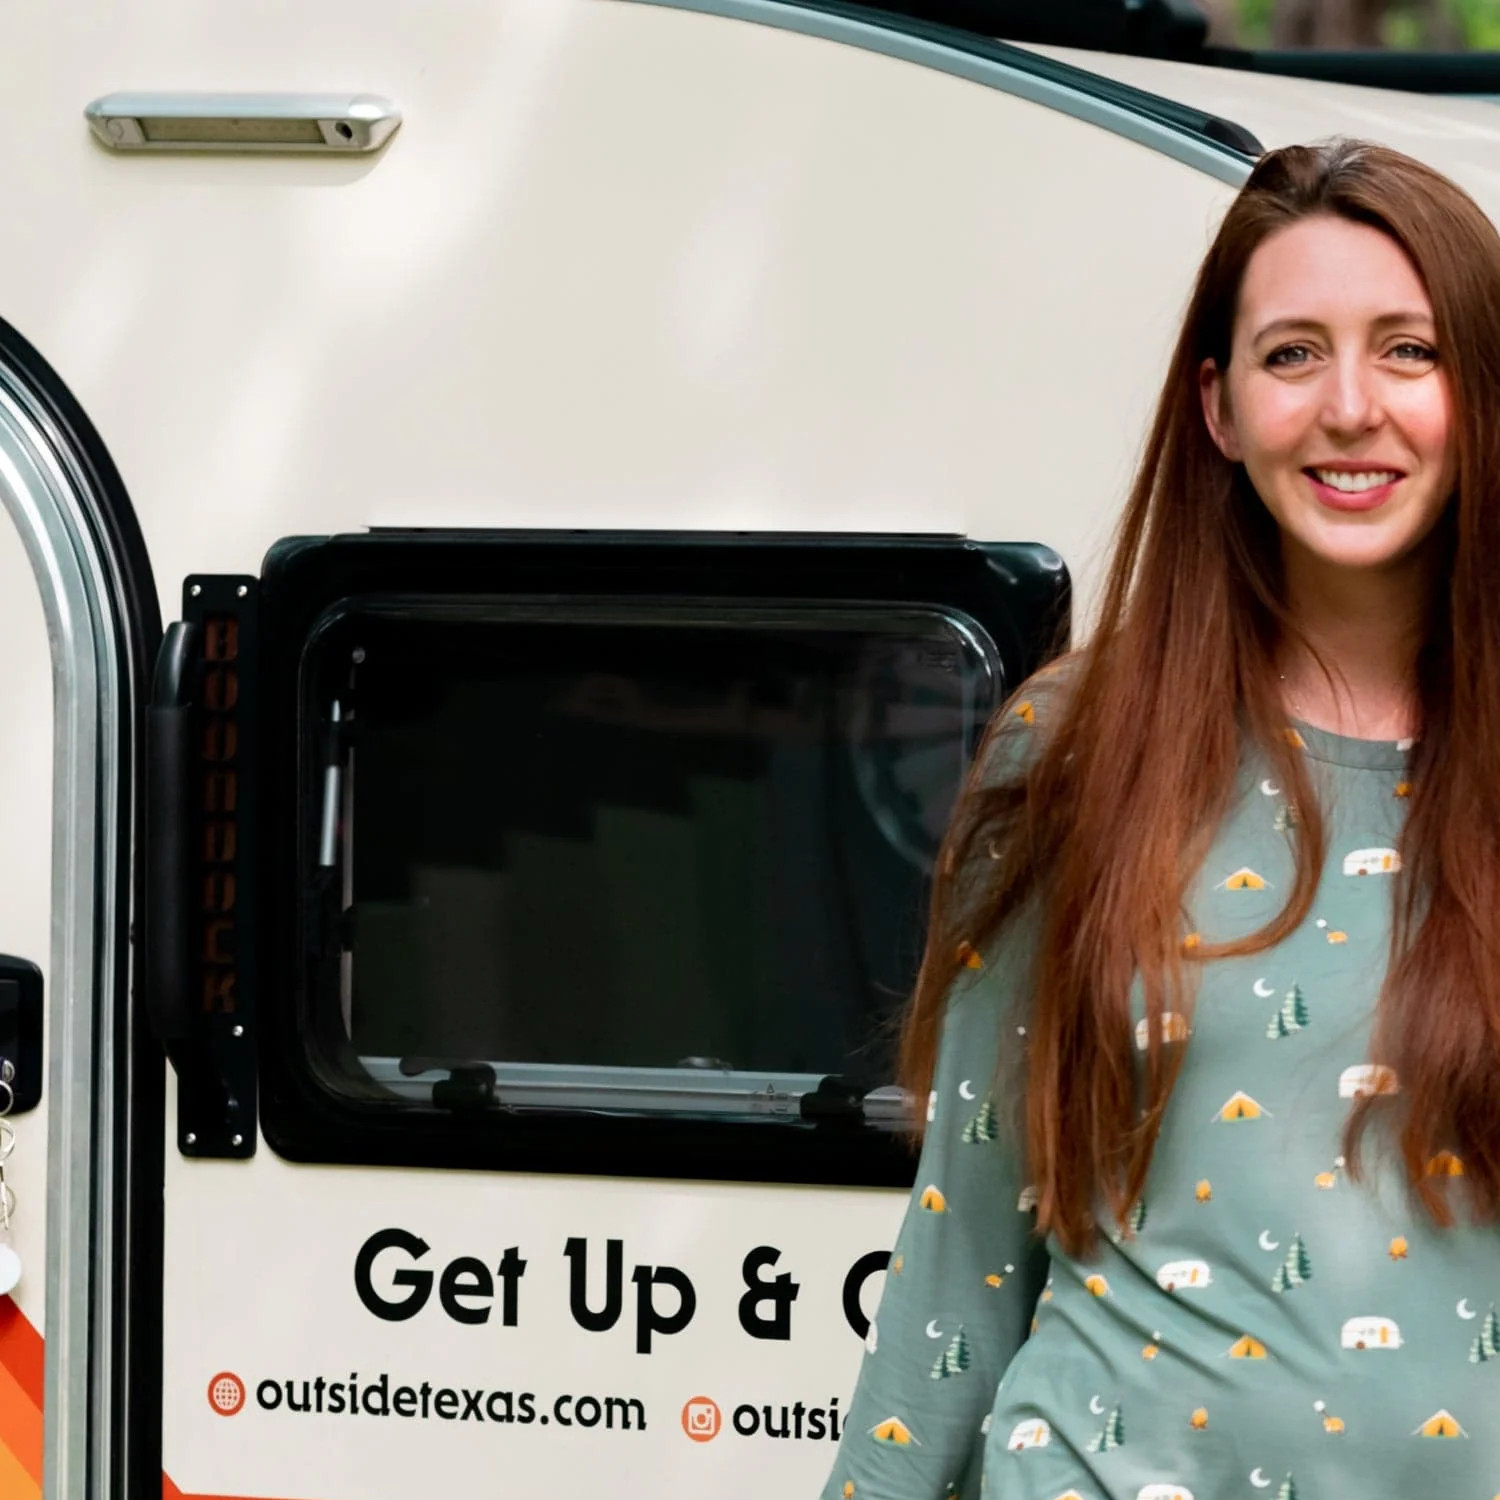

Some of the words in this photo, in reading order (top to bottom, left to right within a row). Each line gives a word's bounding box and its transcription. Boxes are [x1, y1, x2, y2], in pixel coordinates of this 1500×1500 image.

[354, 1227, 527, 1327] Get
[564, 1237, 696, 1354] Up
[738, 1245, 800, 1341] &
[256, 1371, 648, 1431] outsidetexas.com
[733, 1397, 849, 1441] outsi
